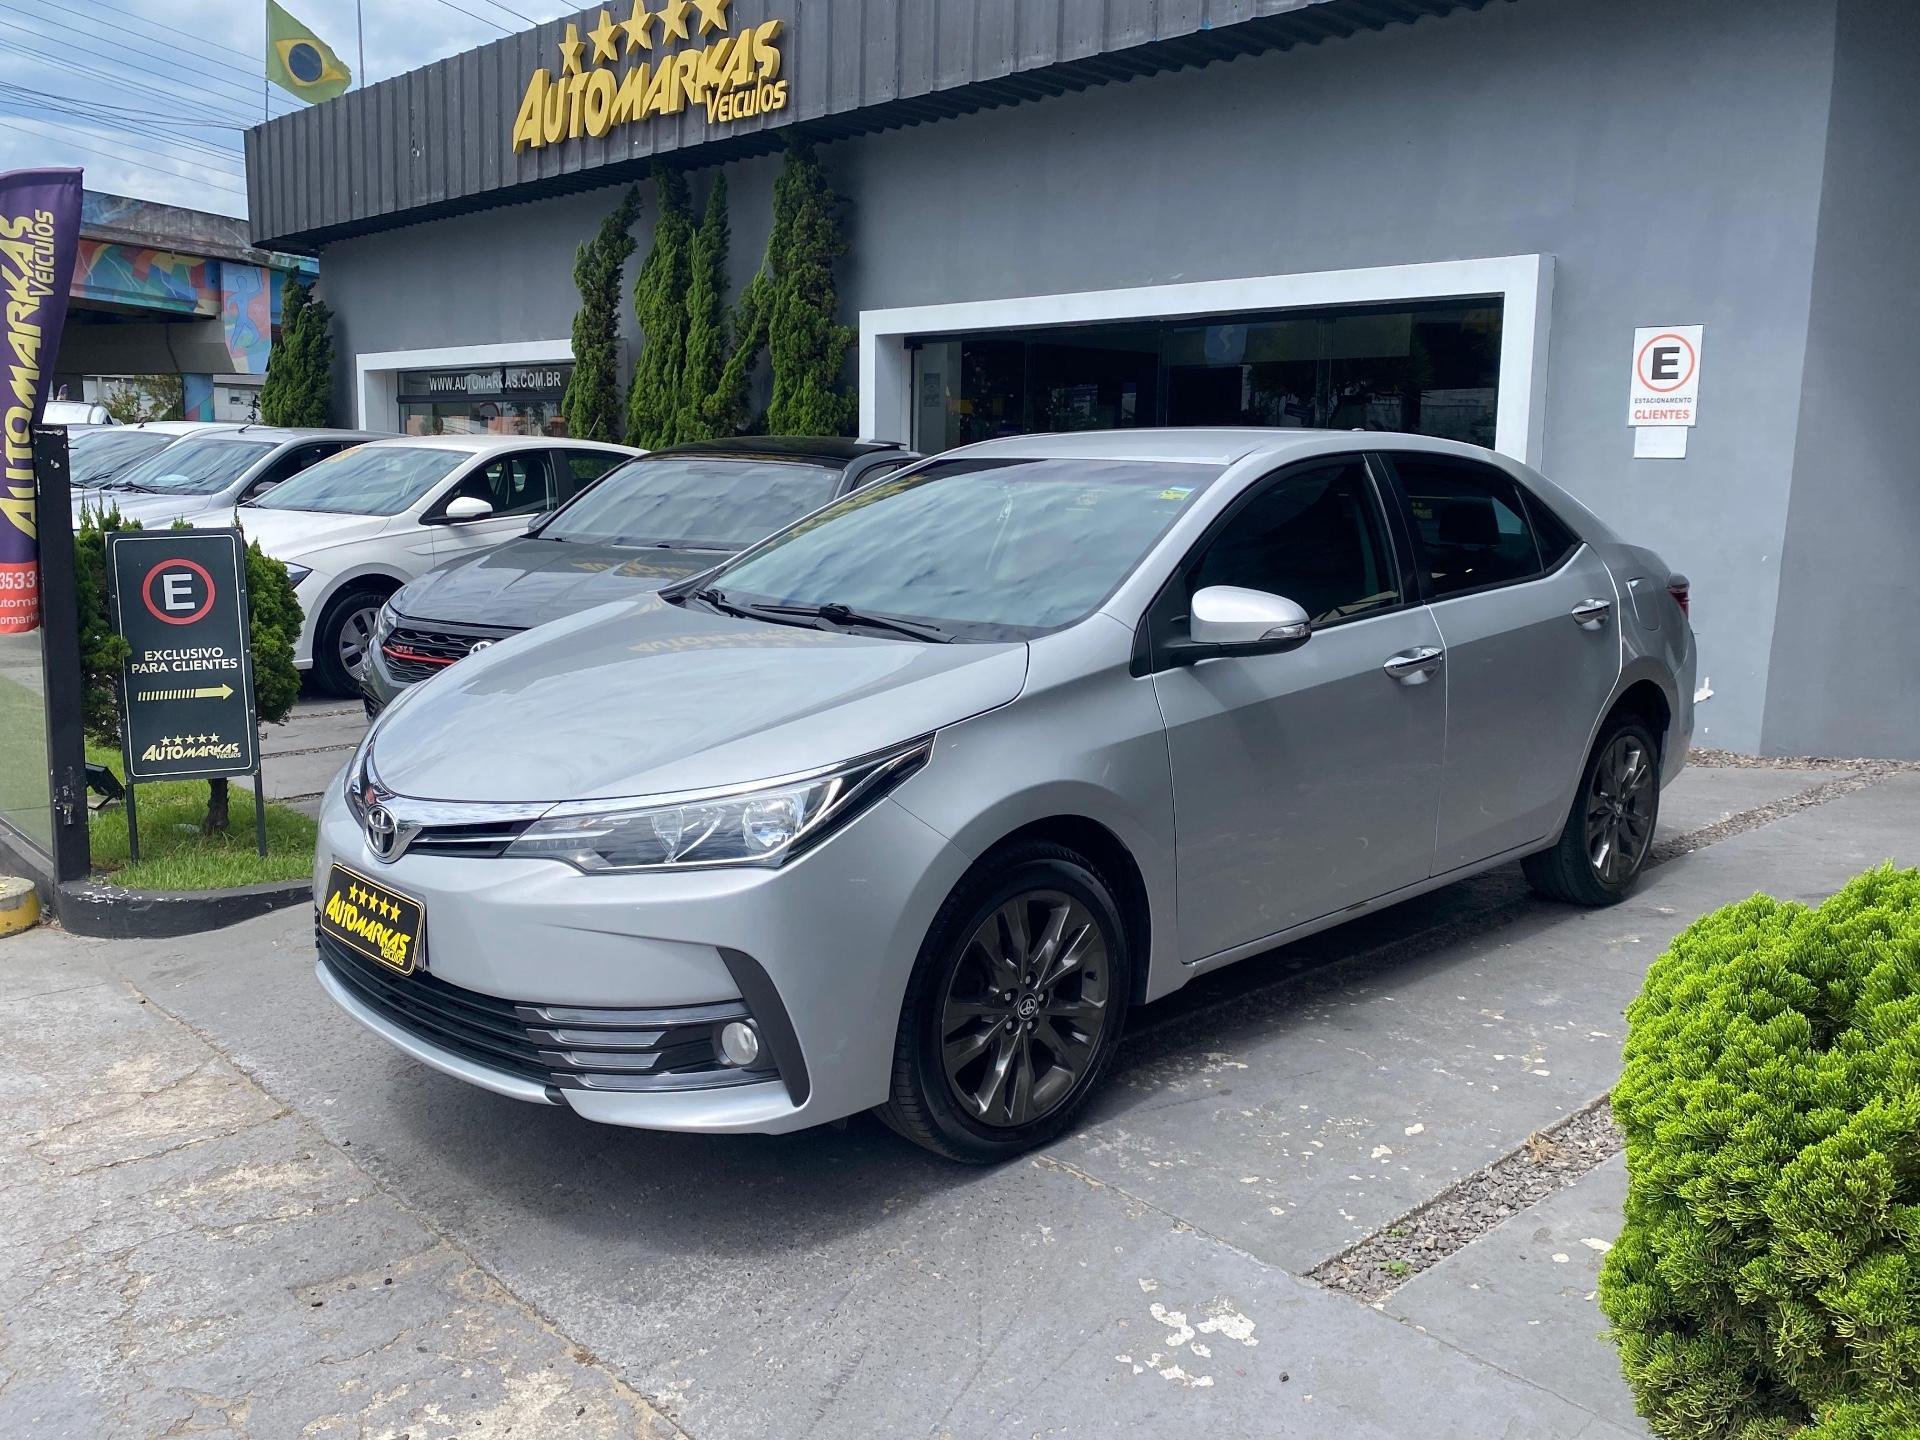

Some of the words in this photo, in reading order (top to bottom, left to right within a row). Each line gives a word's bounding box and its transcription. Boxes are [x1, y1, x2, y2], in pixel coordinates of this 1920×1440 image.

[513, 20, 784, 154] AUTOMARKAS
[1651, 346, 1681, 381] E
[1634, 409, 1690, 420] CLIENTES
[162, 573, 196, 611] E
[131, 660, 169, 674] PARA
[172, 657, 238, 672] CLIENTES
[144, 646, 224, 662] EXCLUSIVO
[141, 743, 239, 761] AUTOMARKAS
[325, 890, 411, 956] AUTOMARKAS
